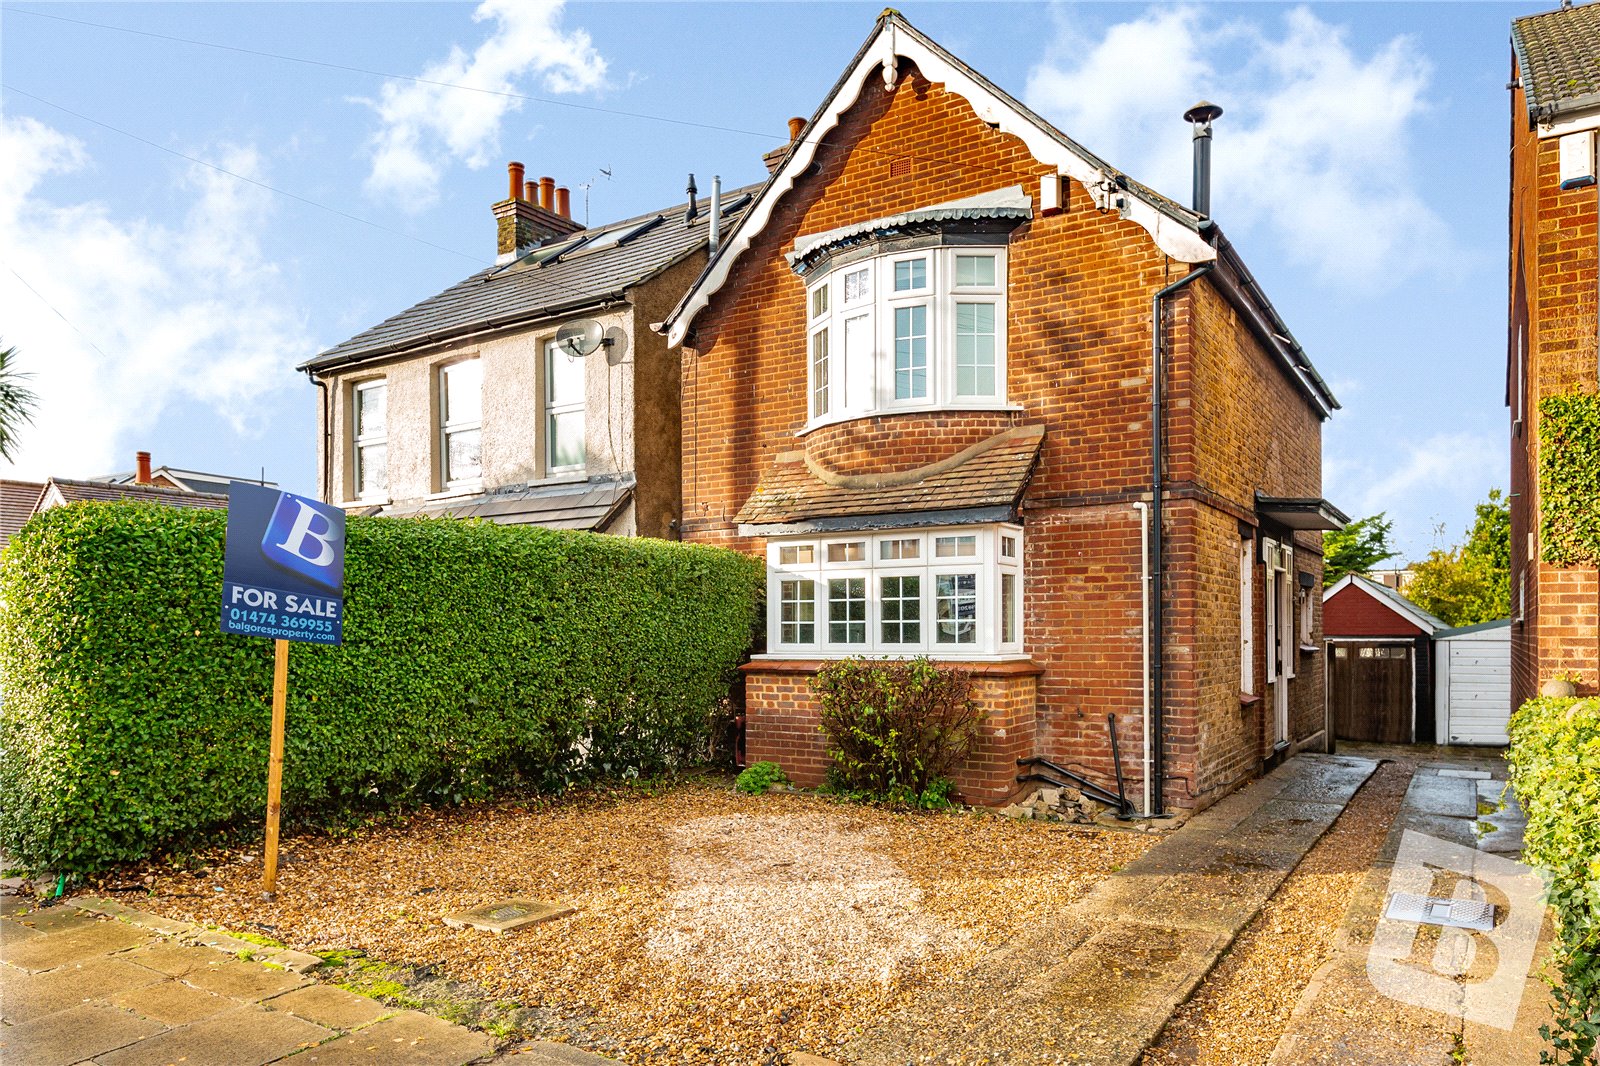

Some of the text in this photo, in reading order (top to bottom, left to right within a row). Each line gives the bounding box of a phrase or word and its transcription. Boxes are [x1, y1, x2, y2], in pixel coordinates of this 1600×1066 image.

[276, 498, 341, 567] B
[231, 586, 337, 618] FOR SALE
[228, 620, 336, 641] balgoresproperty.com
[230, 608, 333, 632] 01474 369955
